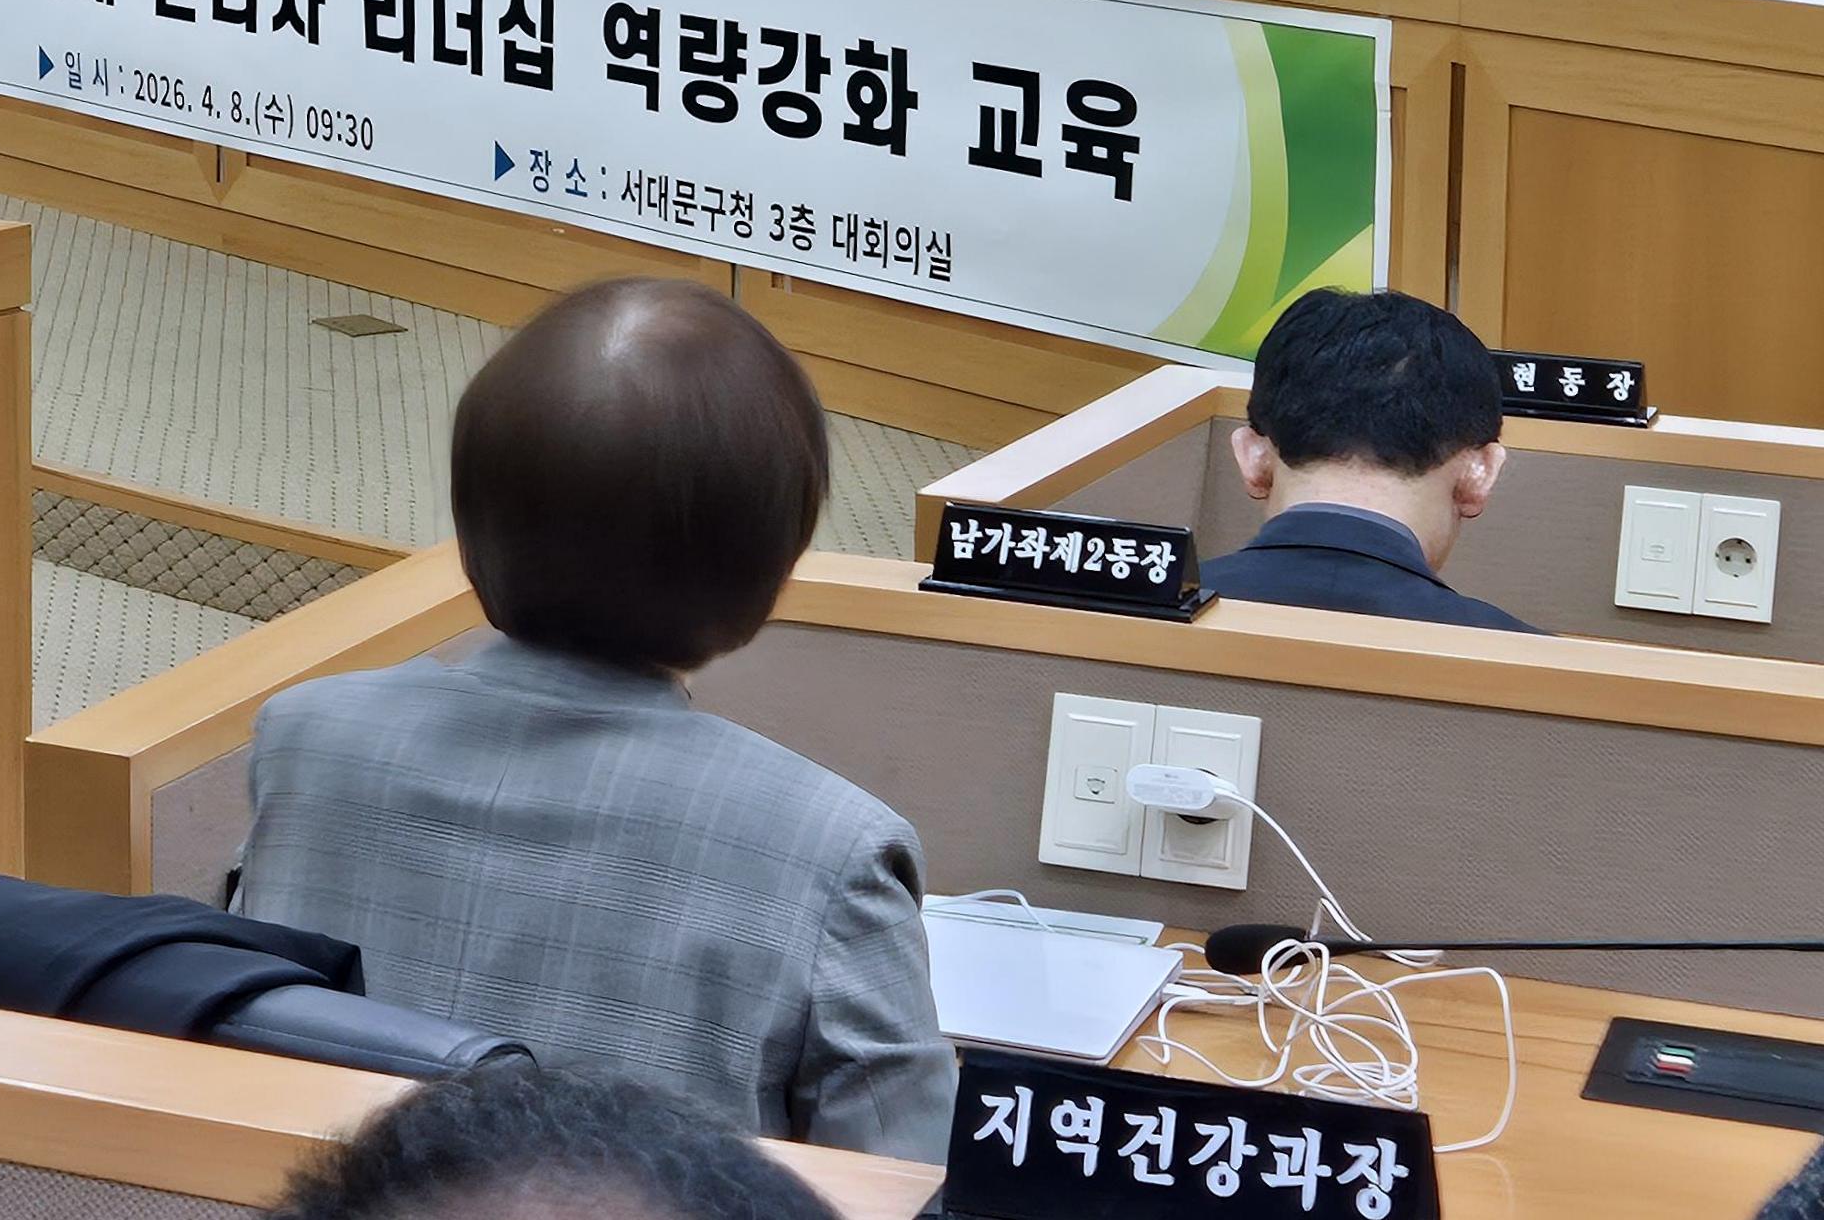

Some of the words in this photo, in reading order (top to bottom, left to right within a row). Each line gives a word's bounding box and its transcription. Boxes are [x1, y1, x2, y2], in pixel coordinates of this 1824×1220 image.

[133, 69, 193, 112] 2026.
[201, 84, 222, 120] 4.
[230, 90, 295, 139] 8.(수)
[306, 105, 375, 152] 09:30
[602, 0, 920, 158] 역량강화
[967, 61, 1141, 204] 교육
[620, 168, 755, 241] 서대문구청
[768, 203, 818, 253] 3층
[832, 211, 954, 283] 대회의실
[950, 518, 1177, 585] 남가좌제2동장
[974, 1084, 1410, 1220] 지역건강과장
